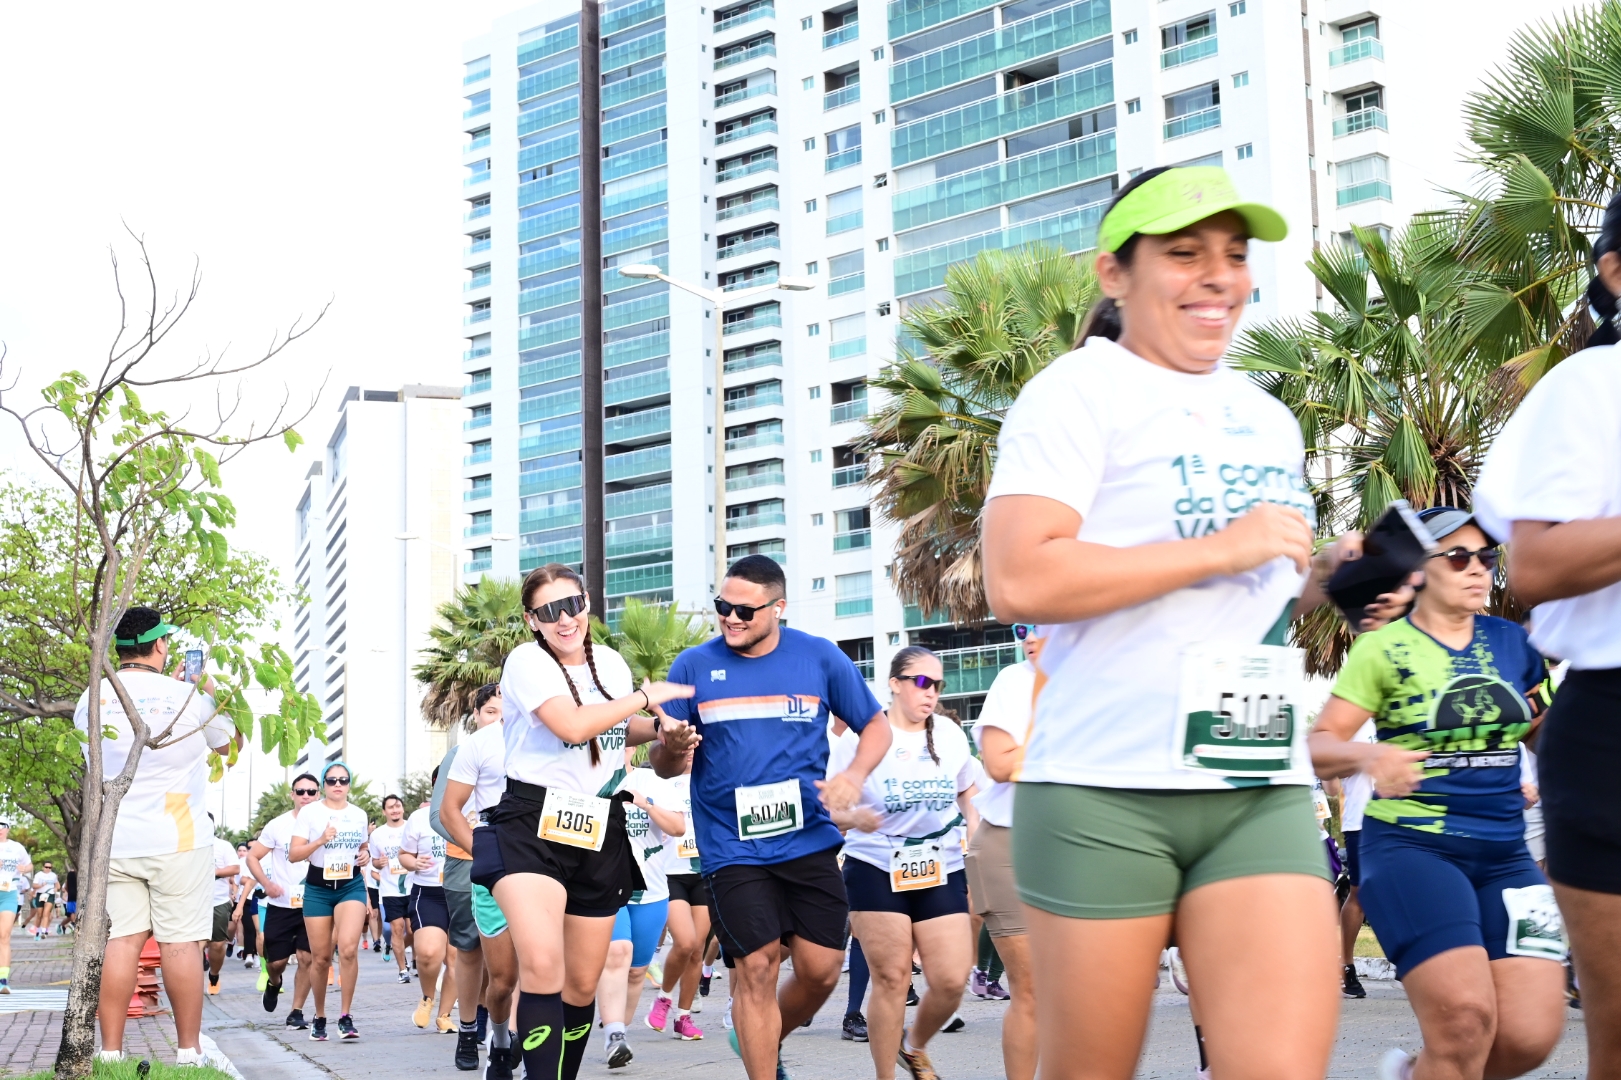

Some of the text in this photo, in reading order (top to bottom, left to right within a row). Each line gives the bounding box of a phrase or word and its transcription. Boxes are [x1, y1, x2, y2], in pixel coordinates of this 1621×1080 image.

[1171, 454, 1205, 487] 1ª
[1175, 487, 1214, 515] da
[884, 778, 898, 791] 1ª
[885, 792, 900, 802] da
[885, 800, 922, 813] VAPT
[556, 810, 594, 834] 1305
[751, 802, 789, 825] 5079
[901, 860, 936, 878] 2603
